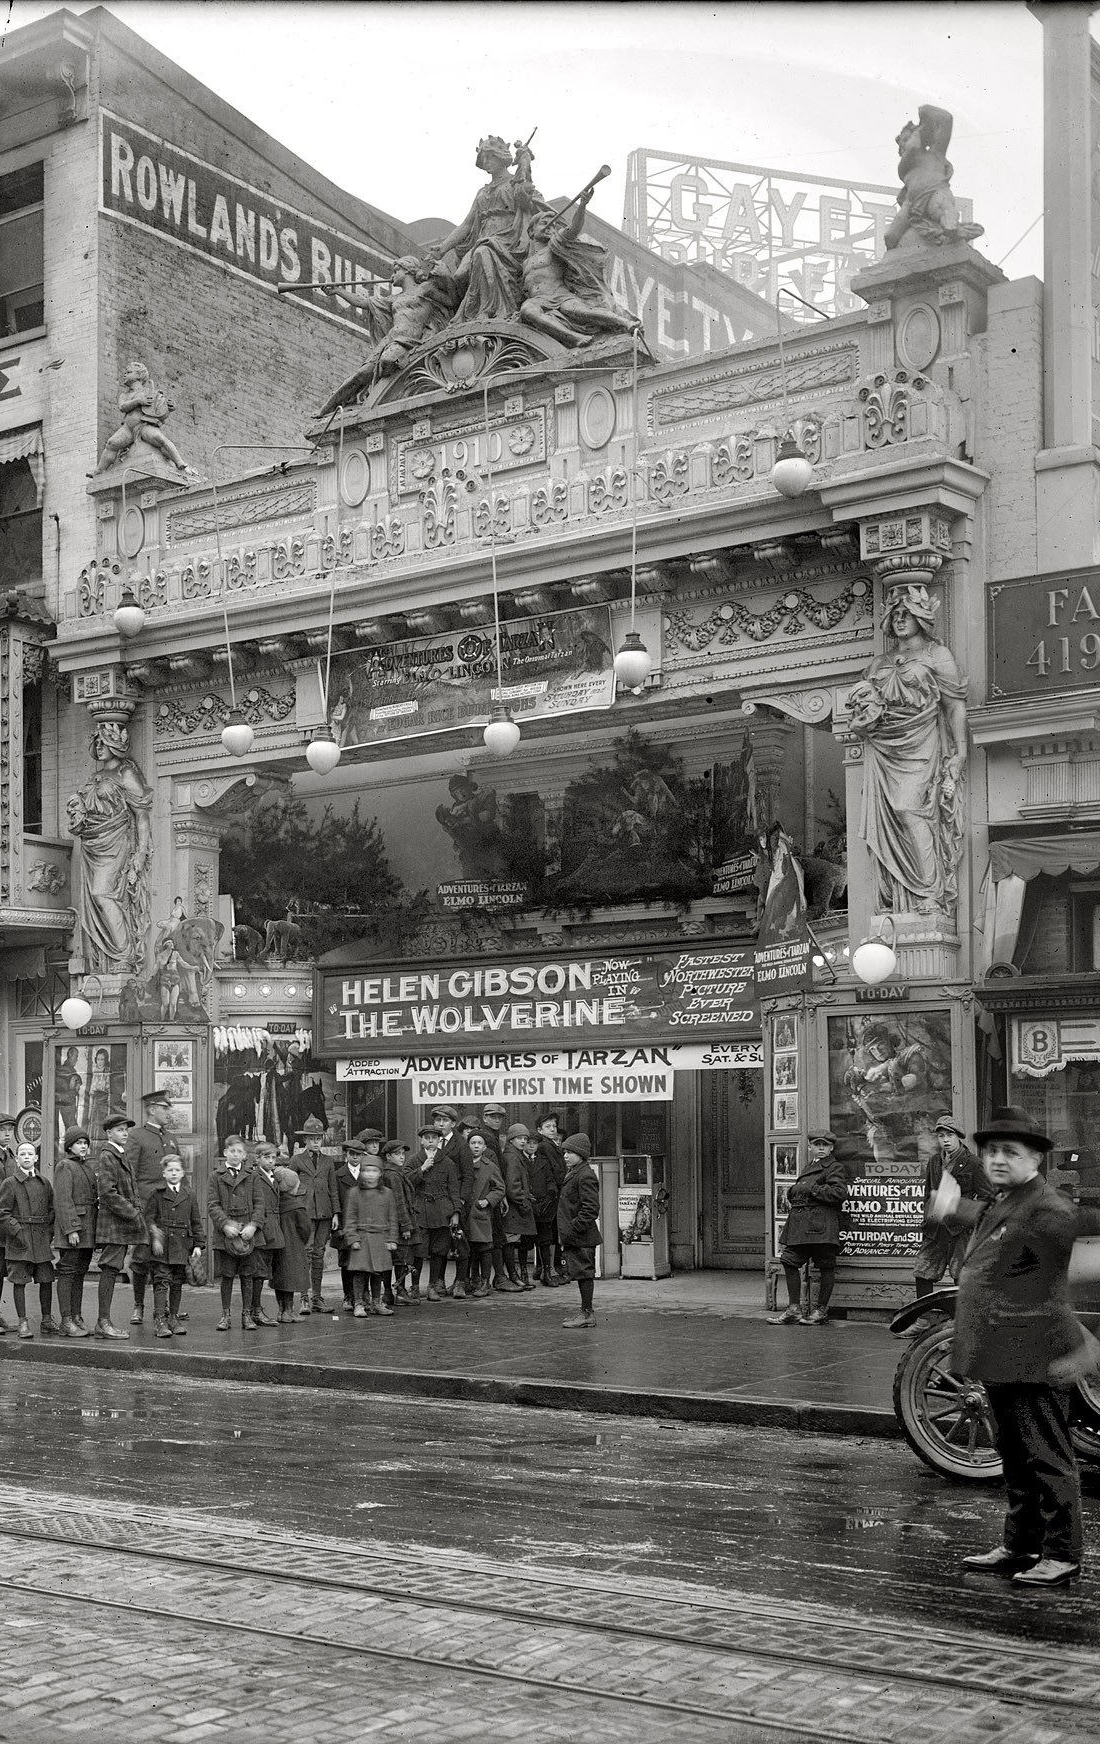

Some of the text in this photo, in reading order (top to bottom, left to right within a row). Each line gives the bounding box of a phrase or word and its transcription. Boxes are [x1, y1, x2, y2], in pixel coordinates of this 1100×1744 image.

[110, 131, 300, 282] ROWLAND'S
[439, 432, 503, 468] 1910
[366, 645, 454, 679] ADVENTURES
[513, 656, 525, 666] The
[550, 648, 574, 660] Tarzan
[372, 676, 401, 688] Starring
[553, 684, 573, 693] SHOWN
[574, 681, 588, 691] HERE
[588, 679, 607, 688] EVERY
[544, 688, 591, 702] SATURDAY
[548, 695, 594, 709] SUNDAY
[388, 711, 425, 732] EDGAR
[713, 880, 731, 893] ELMO
[443, 893, 525, 906] ELMO LINCOLN
[601, 958, 630, 975] NOW
[673, 952, 746, 970] FASTEST
[592, 968, 641, 986] PLAYING
[757, 967, 777, 982] ELMO
[778, 962, 807, 979] LINCOLN
[341, 962, 592, 1006] HELEN GIBSON
[607, 983, 629, 997] IN
[678, 981, 748, 999] PICTURE
[686, 997, 734, 1011] EVER
[668, 1010, 754, 1026] SCREENED
[711, 1043, 762, 1054] EVERY
[1032, 1030, 1049, 1053] B
[343, 1066, 400, 1078] ATTRACTION
[701, 1053, 731, 1065] SAT.
[734, 1052, 747, 1063] &
[348, 1059, 381, 1068] ADDED
[418, 1074, 667, 1098] POSITIVELY FIRST TIME SHOWN
[865, 1164, 920, 1175] TO-DAY
[853, 1176, 881, 1184] SPECIAL
[841, 1199, 882, 1213] ELMO
[839, 1231, 894, 1241] SATURDAY
[893, 1233, 907, 1242] and
[850, 1247, 891, 1256] ADVANCE
